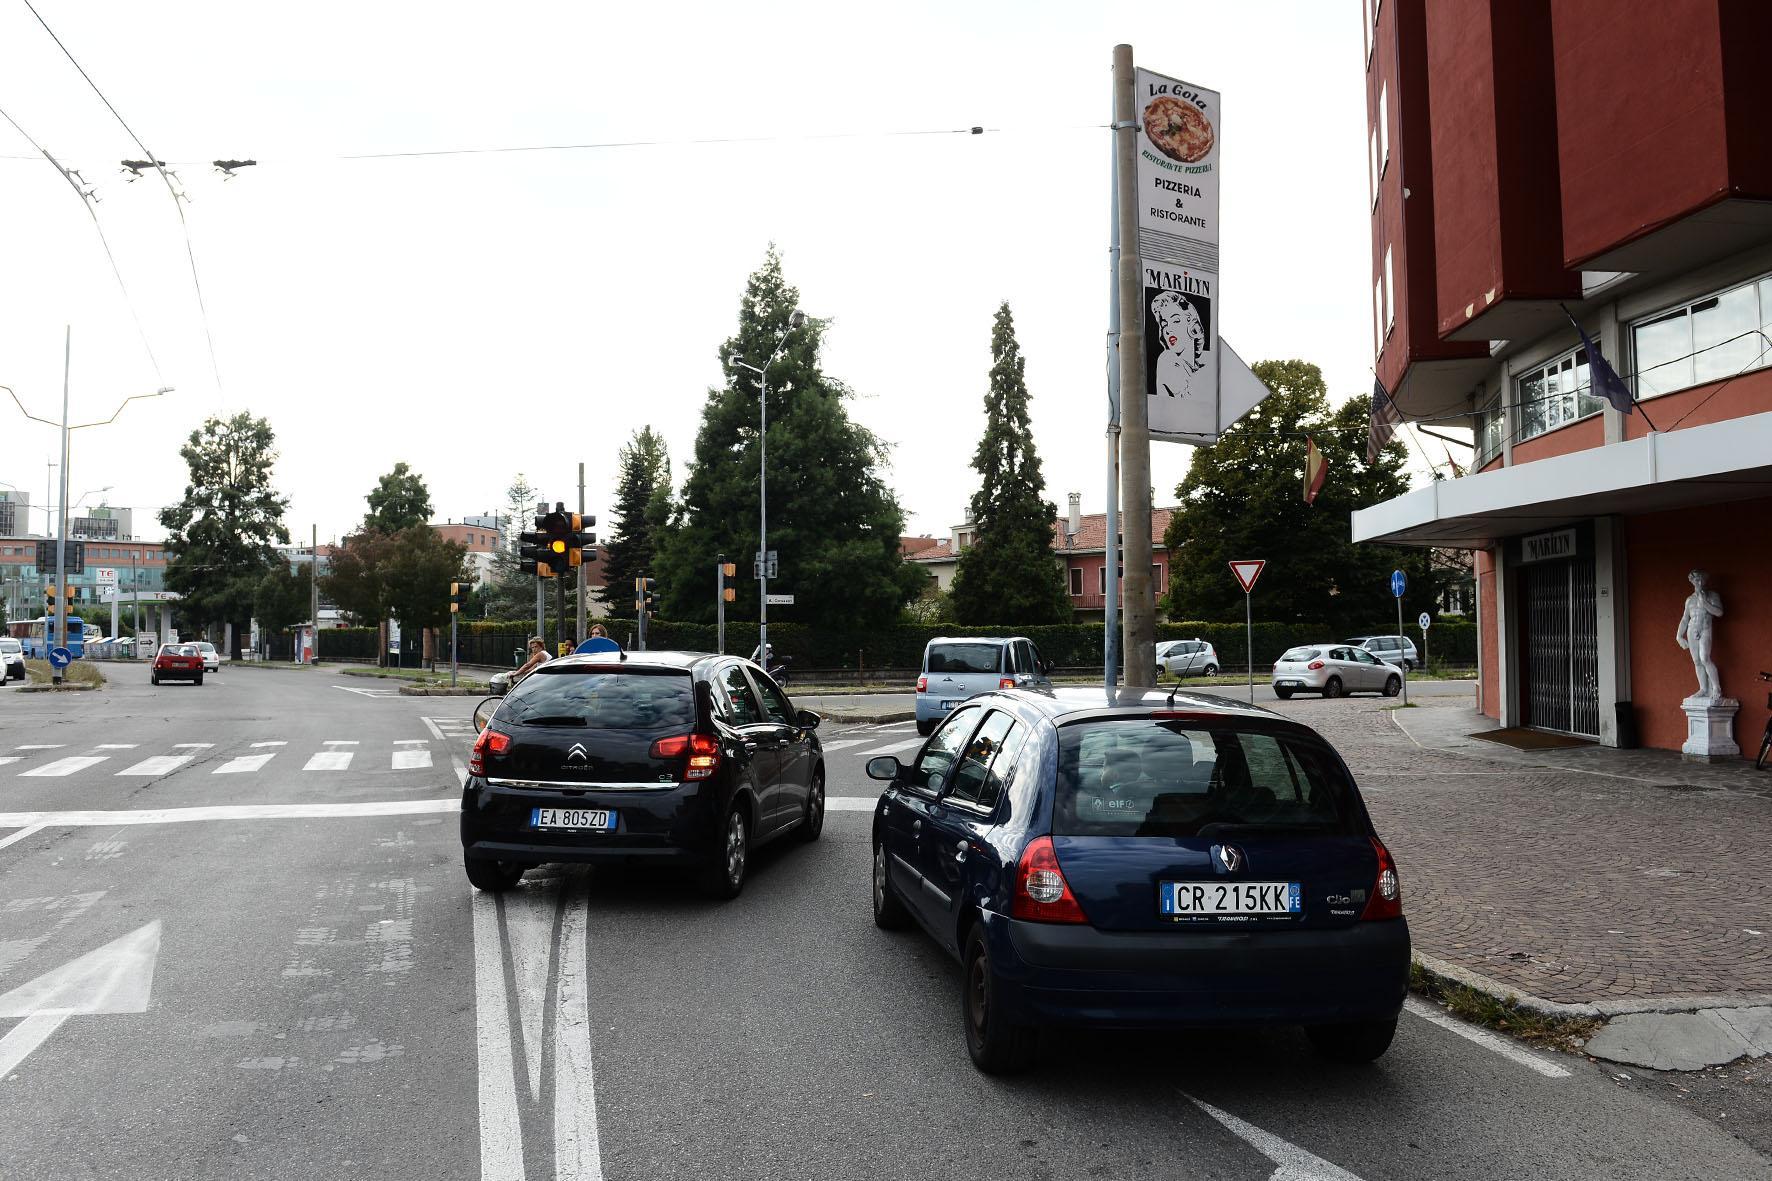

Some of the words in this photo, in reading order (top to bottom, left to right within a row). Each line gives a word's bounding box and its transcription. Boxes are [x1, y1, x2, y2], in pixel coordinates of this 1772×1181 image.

[1149, 83, 1168, 97] La
[1171, 84, 1207, 110] Gola
[1141, 149, 1183, 173] RISTORANTE
[1185, 163, 1212, 175] PIZZERIA
[1154, 177, 1202, 199] PIZZERIA
[1175, 198, 1184, 209] &
[1150, 207, 1207, 229] RISTORANTE
[1145, 268, 1211, 297] MARILYN
[1527, 533, 1571, 560] MARILYN
[540, 809, 557, 825] EA
[562, 810, 607, 827] 805ZD
[1166, 899, 1170, 911] I
[1177, 885, 1205, 911] CR
[1215, 885, 1286, 911] 215KK
[1289, 896, 1300, 908] FE
[1326, 894, 1351, 904] Clio
